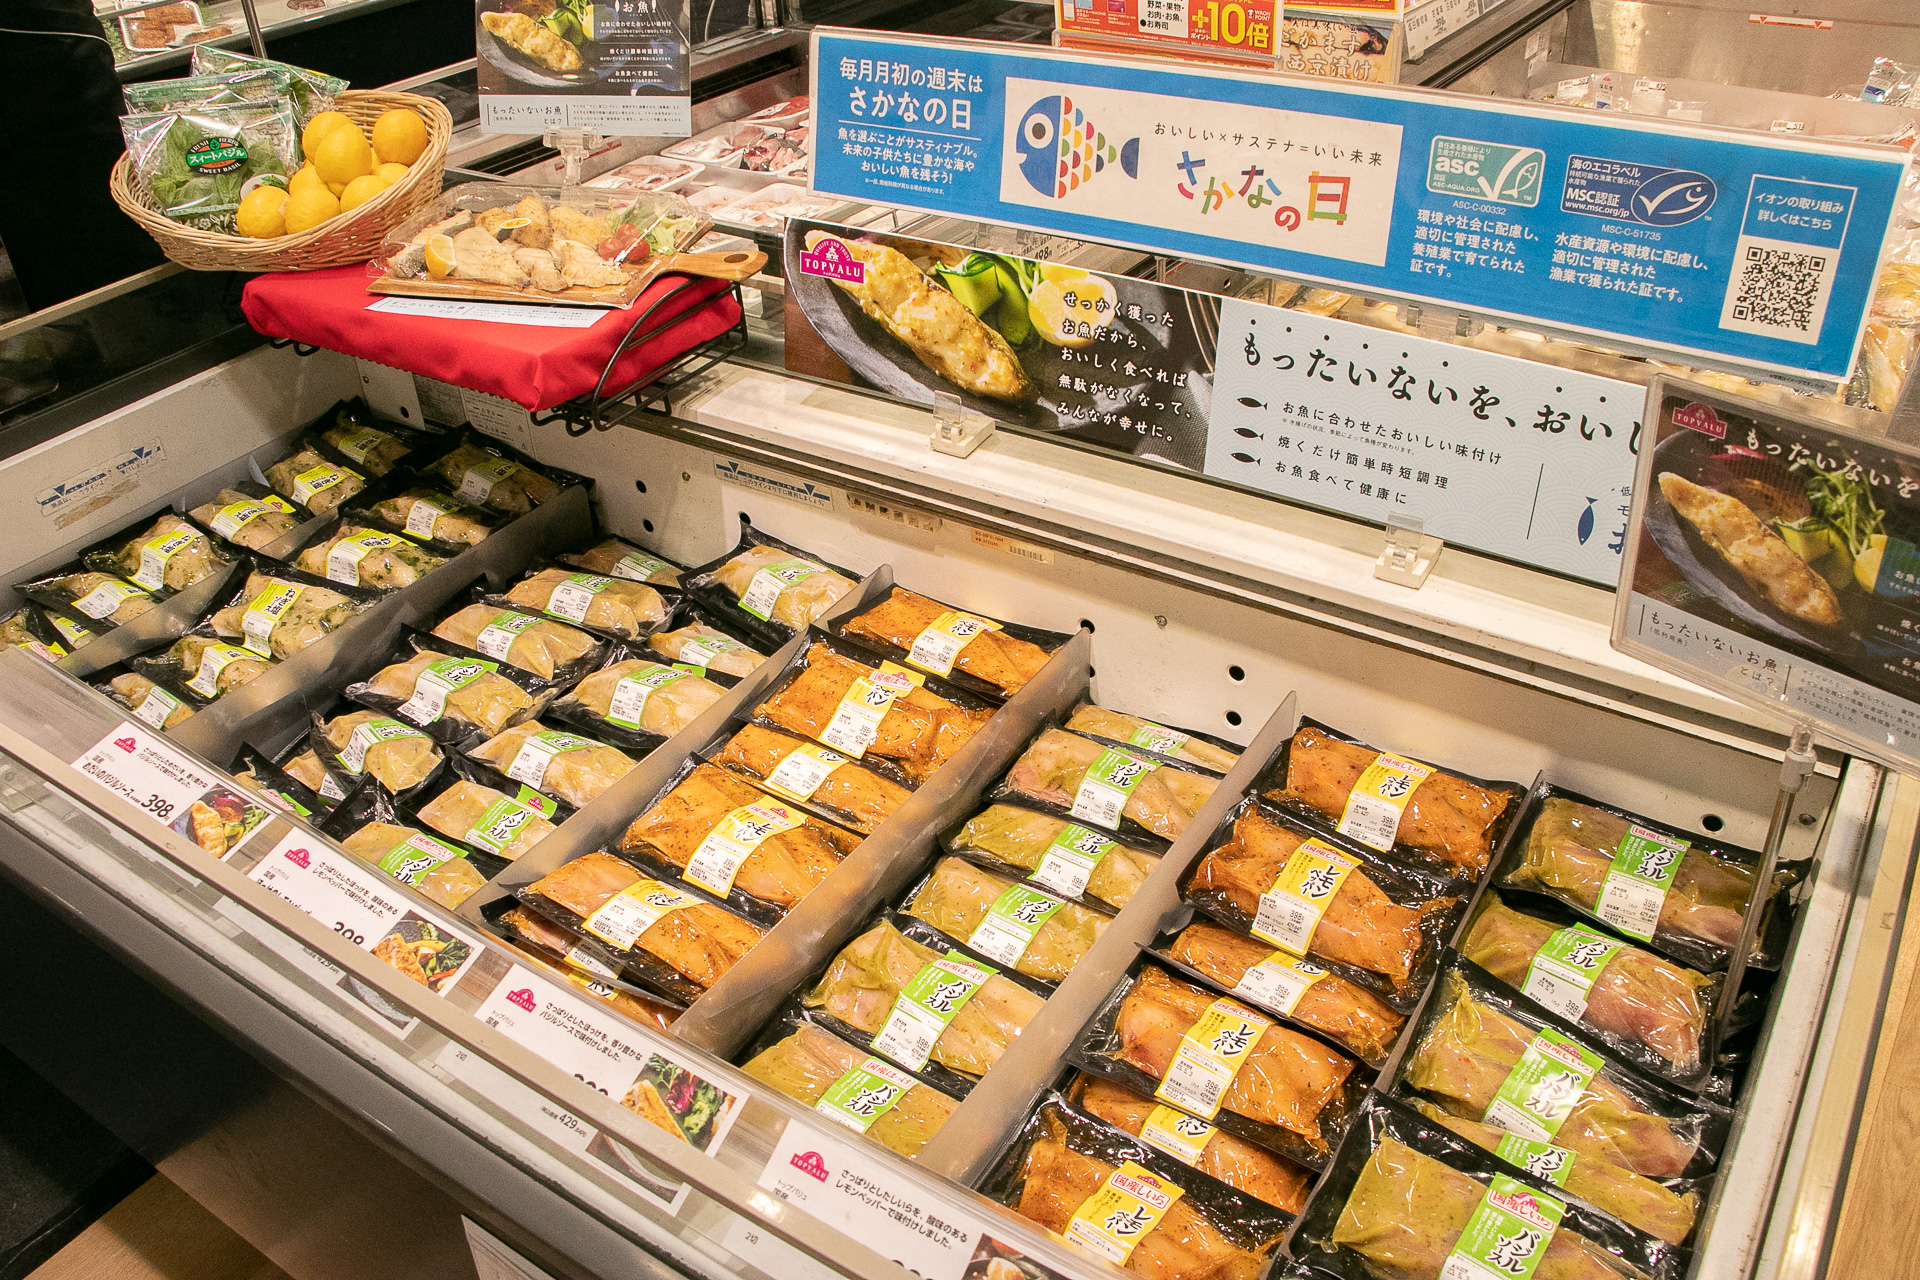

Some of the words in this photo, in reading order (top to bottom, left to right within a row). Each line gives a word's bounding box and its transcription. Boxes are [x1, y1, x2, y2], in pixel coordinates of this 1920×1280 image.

[1147, 10, 1183, 22] お肉・お魚、
[1254, 9, 1271, 17] WAON
[1190, 32, 1211, 41] ポイント
[839, 56, 983, 93] 毎月月初の週末は
[1287, 53, 1371, 81] 西京漬け
[492, 105, 562, 115] もったいないお魚
[849, 85, 972, 130] さかなの日
[837, 126, 978, 158] 魚を選ぶことがサスティナブル。
[1437, 141, 1491, 155] 責任ある養殖により
[1437, 149, 1485, 161] 生産された水産物
[222, 162, 242, 172] BASIL
[842, 142, 975, 172] 未来の子供たちに豊かな海や
[1435, 156, 1480, 177] asc
[1571, 158, 1641, 178] 海のエコラベル
[1176, 150, 1351, 231] さかなの日
[1432, 181, 1480, 194] ASC-AQUA.ORG
[1567, 177, 1587, 187] 水産物
[1569, 169, 1641, 187] 持続可能な漁業で獲られた
[1452, 200, 1507, 216] ASC-C-00332
[1564, 200, 1630, 218] www.msc.org/jp
[1566, 187, 1621, 207] MSC認証
[1754, 192, 1844, 214] イオンの取り組み
[1416, 209, 1539, 242] 環境や社会に配慮し、
[1601, 223, 1661, 241] MSC-C-51735
[1757, 209, 1832, 231] 詳しくはこちら
[814, 240, 830, 256] QUALITY
[830, 239, 840, 248] AND
[1414, 225, 1516, 255] 適切に管理された
[1554, 232, 1709, 271] 水産資源や環境に配慮し、
[804, 257, 861, 278] TOPVALU
[1409, 258, 1451, 278] 証です。
[1412, 242, 1525, 274] 養殖業で育てられた
[1551, 249, 1656, 280] 適切に管理された
[1549, 266, 1683, 303] 漁業で獲られた証です。
[1064, 292, 1174, 328] せっかく獲った
[1063, 319, 1147, 351] お魚だから、
[1061, 347, 1187, 388] おいしく食べれば
[1058, 373, 1191, 418] 無駄がなくなって、
[1057, 402, 1173, 442] みんなが幸せに。
[1282, 401, 1502, 465] お魚に合わせたおいしい味付け
[1676, 412, 1723, 434] TOPVALU
[1277, 435, 1448, 490] 焼くだけ簡単時短調理
[1747, 428, 1920, 499] もったいないを
[1275, 461, 1407, 505] お魚食べて健康に
[1651, 611, 1777, 674] もったいないお魚
[1390, 773, 1417, 798] レモン
[490, 814, 509, 835] ソース
[496, 810, 531, 841] バジル
[263, 870, 276, 881] 国産
[1635, 851, 1656, 876] ソース
[1647, 848, 1678, 880] バジル
[1311, 864, 1342, 898] レモン
[1012, 898, 1034, 919] ソース
[1022, 899, 1057, 924] バジル
[1563, 942, 1588, 963] ソース
[1578, 938, 1614, 968] バジル
[508, 992, 535, 1012] TOPVALU
[924, 983, 948, 1007] ソース
[932, 979, 973, 1014] バジル
[539, 1011, 621, 1063] バジルソースで味付けしました。
[545, 1001, 643, 1062] さっぱりとしたほっけを、香り豊かな
[1223, 1023, 1257, 1058] レモン
[455, 1051, 468, 1063] 2切
[866, 1061, 915, 1087] 国産ほっけ
[846, 1088, 872, 1109] ソース
[856, 1084, 899, 1116] バジル
[1524, 1078, 1555, 1110] ソース
[1532, 1070, 1581, 1119] バジル
[793, 1156, 827, 1180] TOPVALU
[777, 1178, 808, 1201] トップバリュ
[1115, 1172, 1169, 1208] 国産しいら
[834, 1178, 952, 1250] レモンペッパーで味付けしました。
[840, 1167, 969, 1244] さっぱりとしたしいらを、酸味のある
[1115, 1204, 1152, 1236] レモン
[745, 1231, 759, 1246] 2切
[1487, 1236, 1512, 1265] ソース
[1501, 1230, 1541, 1273] バジル
